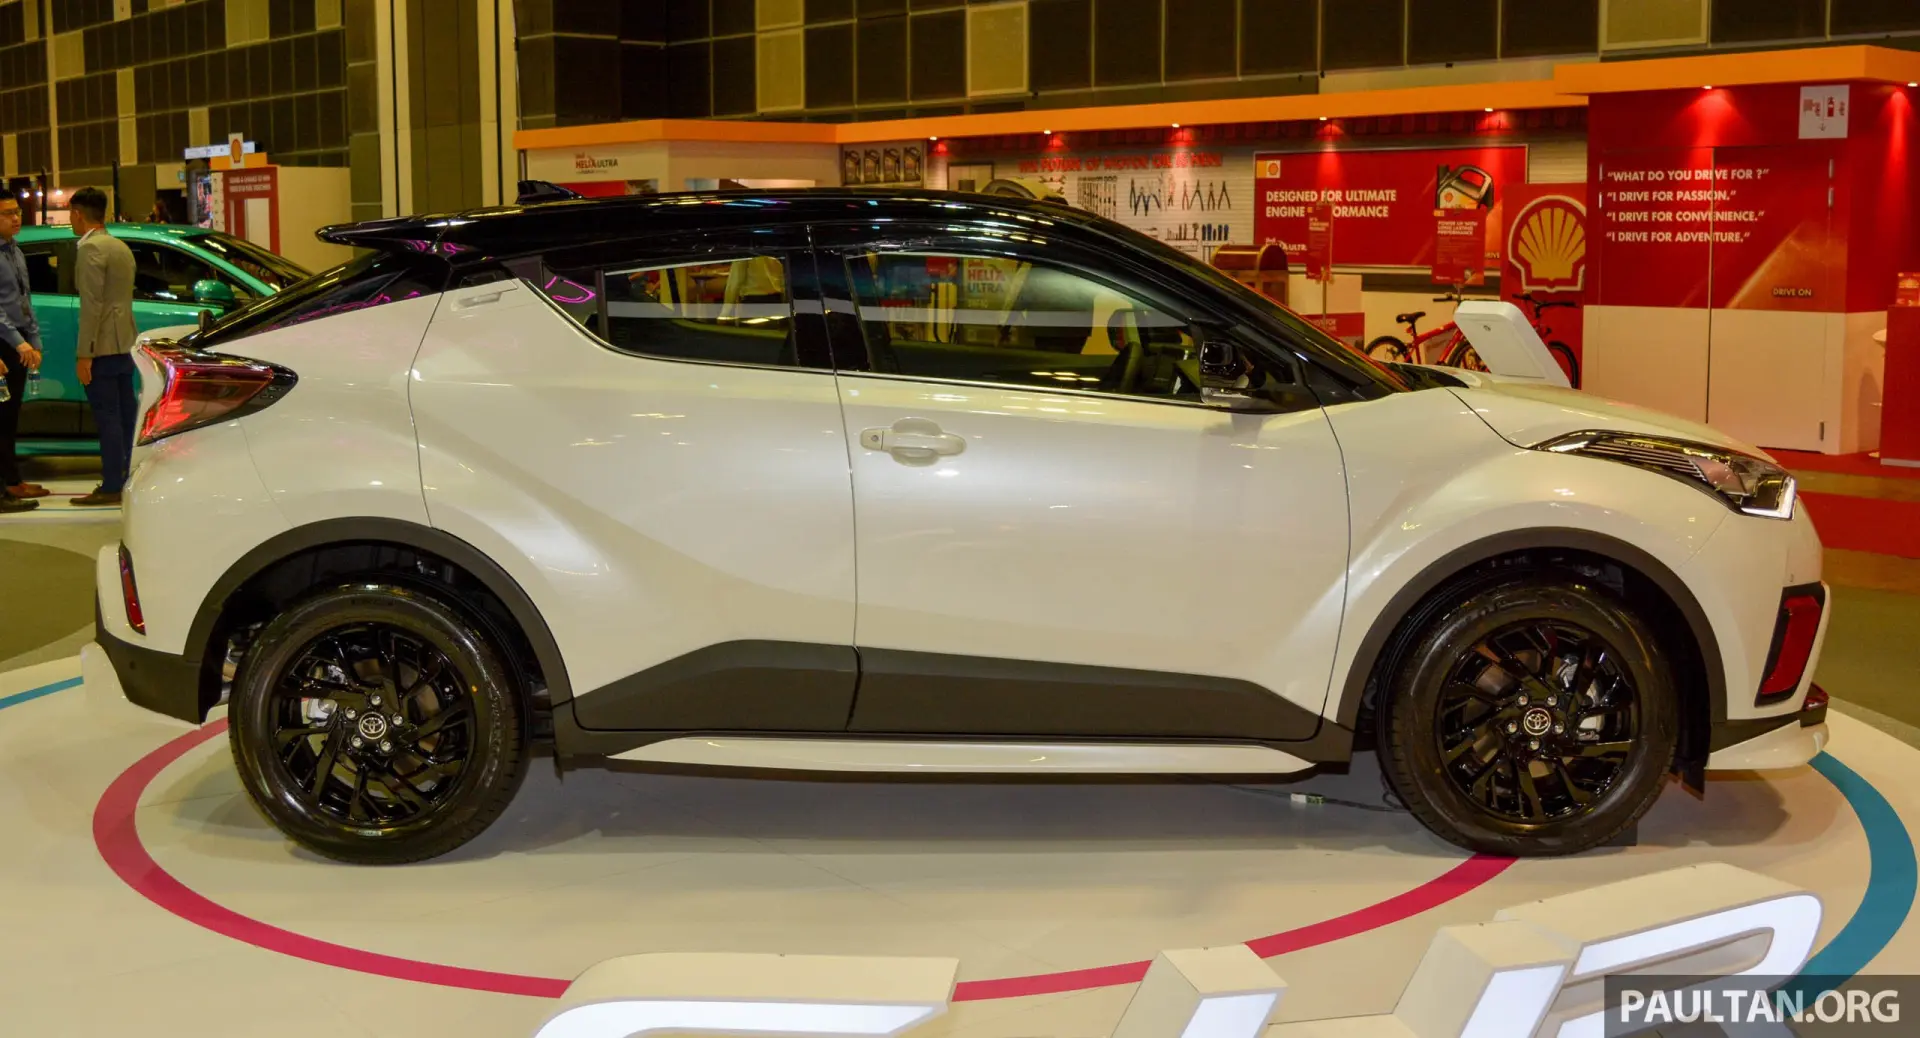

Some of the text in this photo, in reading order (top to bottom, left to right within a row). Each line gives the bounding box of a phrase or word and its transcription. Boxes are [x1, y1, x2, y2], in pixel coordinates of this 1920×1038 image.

[575, 159, 618, 169] HELIX ULTRA
[1607, 171, 1645, 181] "WHAT
[1648, 171, 1664, 181] DO
[1668, 170, 1692, 181] YOU
[1694, 169, 1728, 180] DRIVE
[1731, 169, 1753, 180] FOR
[1266, 189, 1397, 202] DESIGNED FOR ULTIMATE
[1619, 191, 1650, 201] DRIVE
[1652, 191, 1673, 201] FOR
[1676, 190, 1737, 201] PASSION."
[1266, 206, 1305, 217] ENGINE
[1619, 212, 1649, 222] DRIVE
[1651, 211, 1673, 222] FOR
[1618, 232, 1648, 242] DRIVE
[1651, 232, 1672, 242] FOR
[968, 269, 1006, 281] HELIX
[968, 282, 1004, 293] ULTRA
[1773, 288, 1812, 296] DRIVE ON
